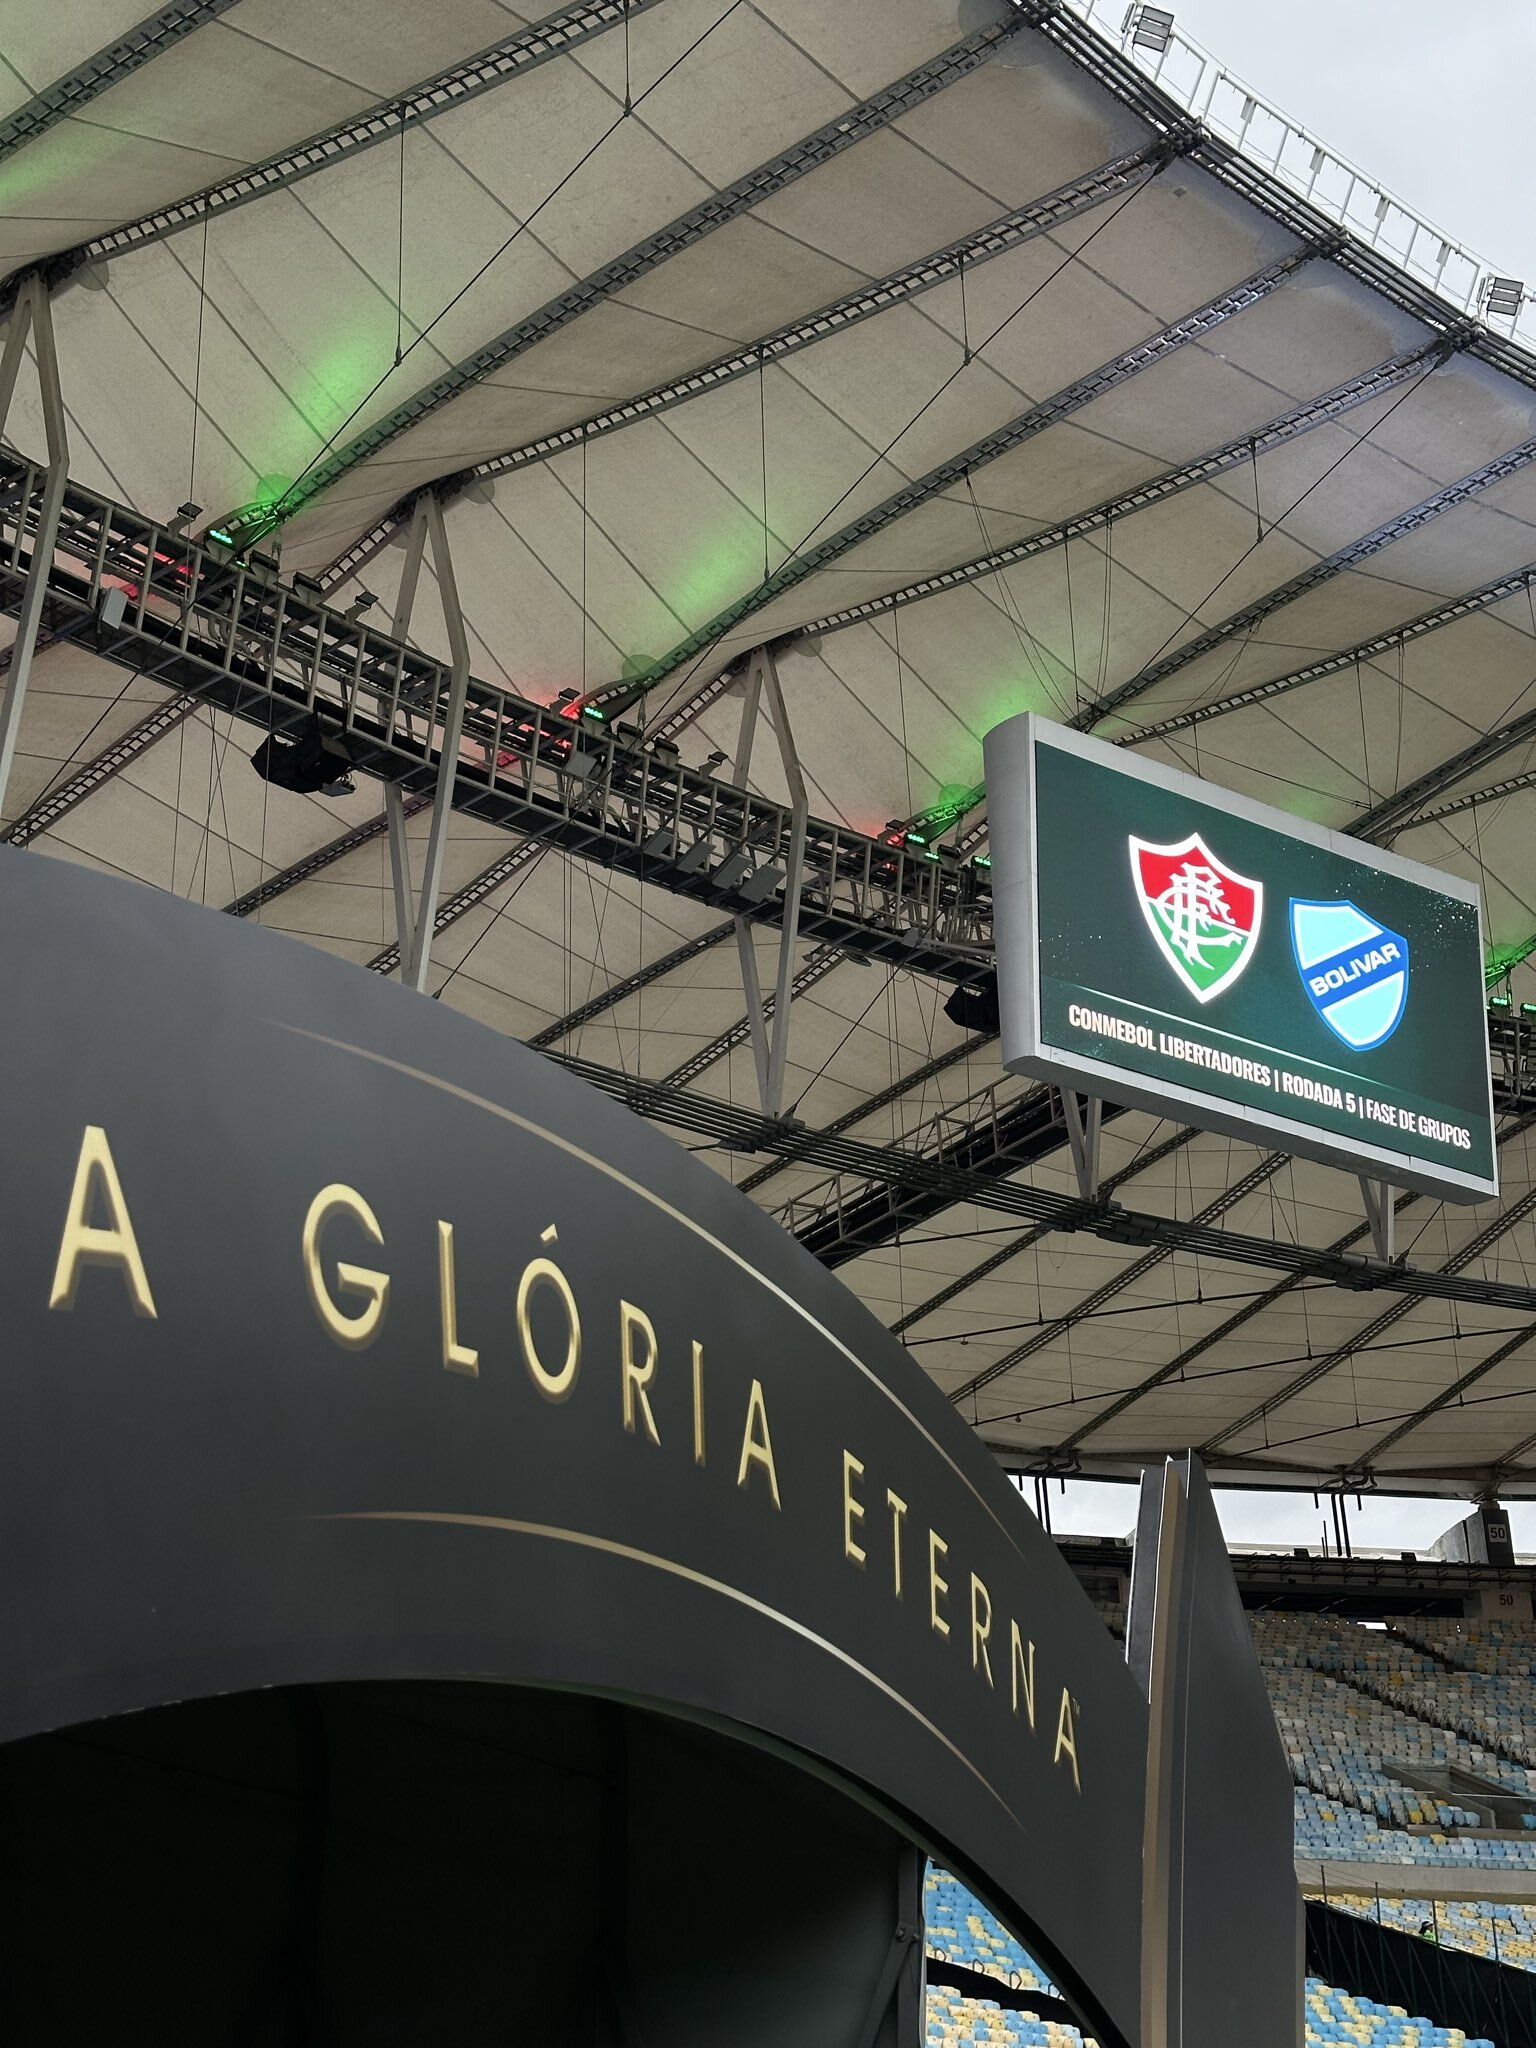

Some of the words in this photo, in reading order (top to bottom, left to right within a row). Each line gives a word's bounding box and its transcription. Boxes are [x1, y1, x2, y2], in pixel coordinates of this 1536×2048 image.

[1308, 942, 1401, 997] BOLIVAR
[1068, 1003, 1157, 1051] CONMEBOL
[1159, 1032, 1271, 1087] LIBERTADORES
[1282, 1071, 1343, 1110] RODADA
[1345, 1092, 1356, 1114] 5
[1365, 1098, 1398, 1127] FASE
[1399, 1108, 1416, 1133] DE
[1418, 1115, 1471, 1149] GRUPOS
[49, 1125, 158, 1319] A
[303, 1182, 782, 1513] GLÓRIA
[1490, 1527, 1506, 1539] 50
[1500, 1594, 1514, 1606] 50
